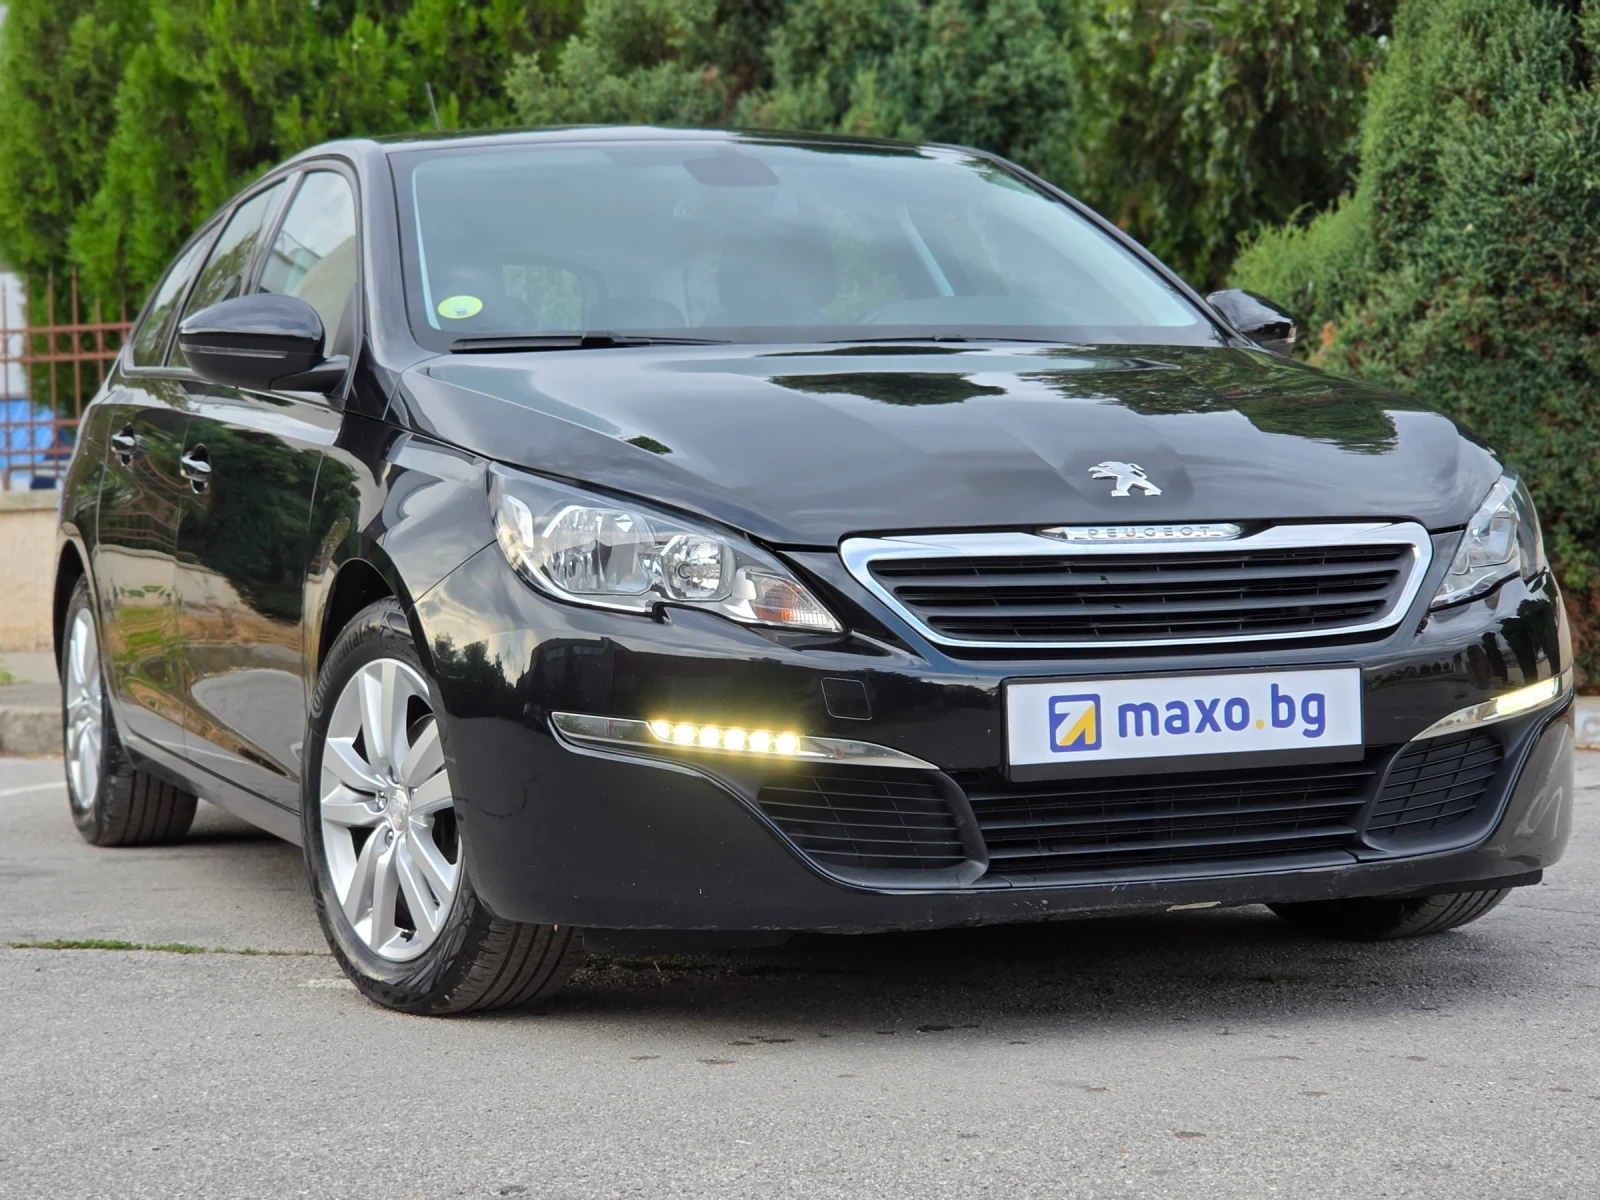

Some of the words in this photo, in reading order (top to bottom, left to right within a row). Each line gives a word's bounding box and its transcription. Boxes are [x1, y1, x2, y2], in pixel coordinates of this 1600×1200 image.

[1087, 526, 1211, 539] PEUGEOT
[310, 622, 365, 718] Contiental
[1117, 683, 1326, 739] maxo.bg
